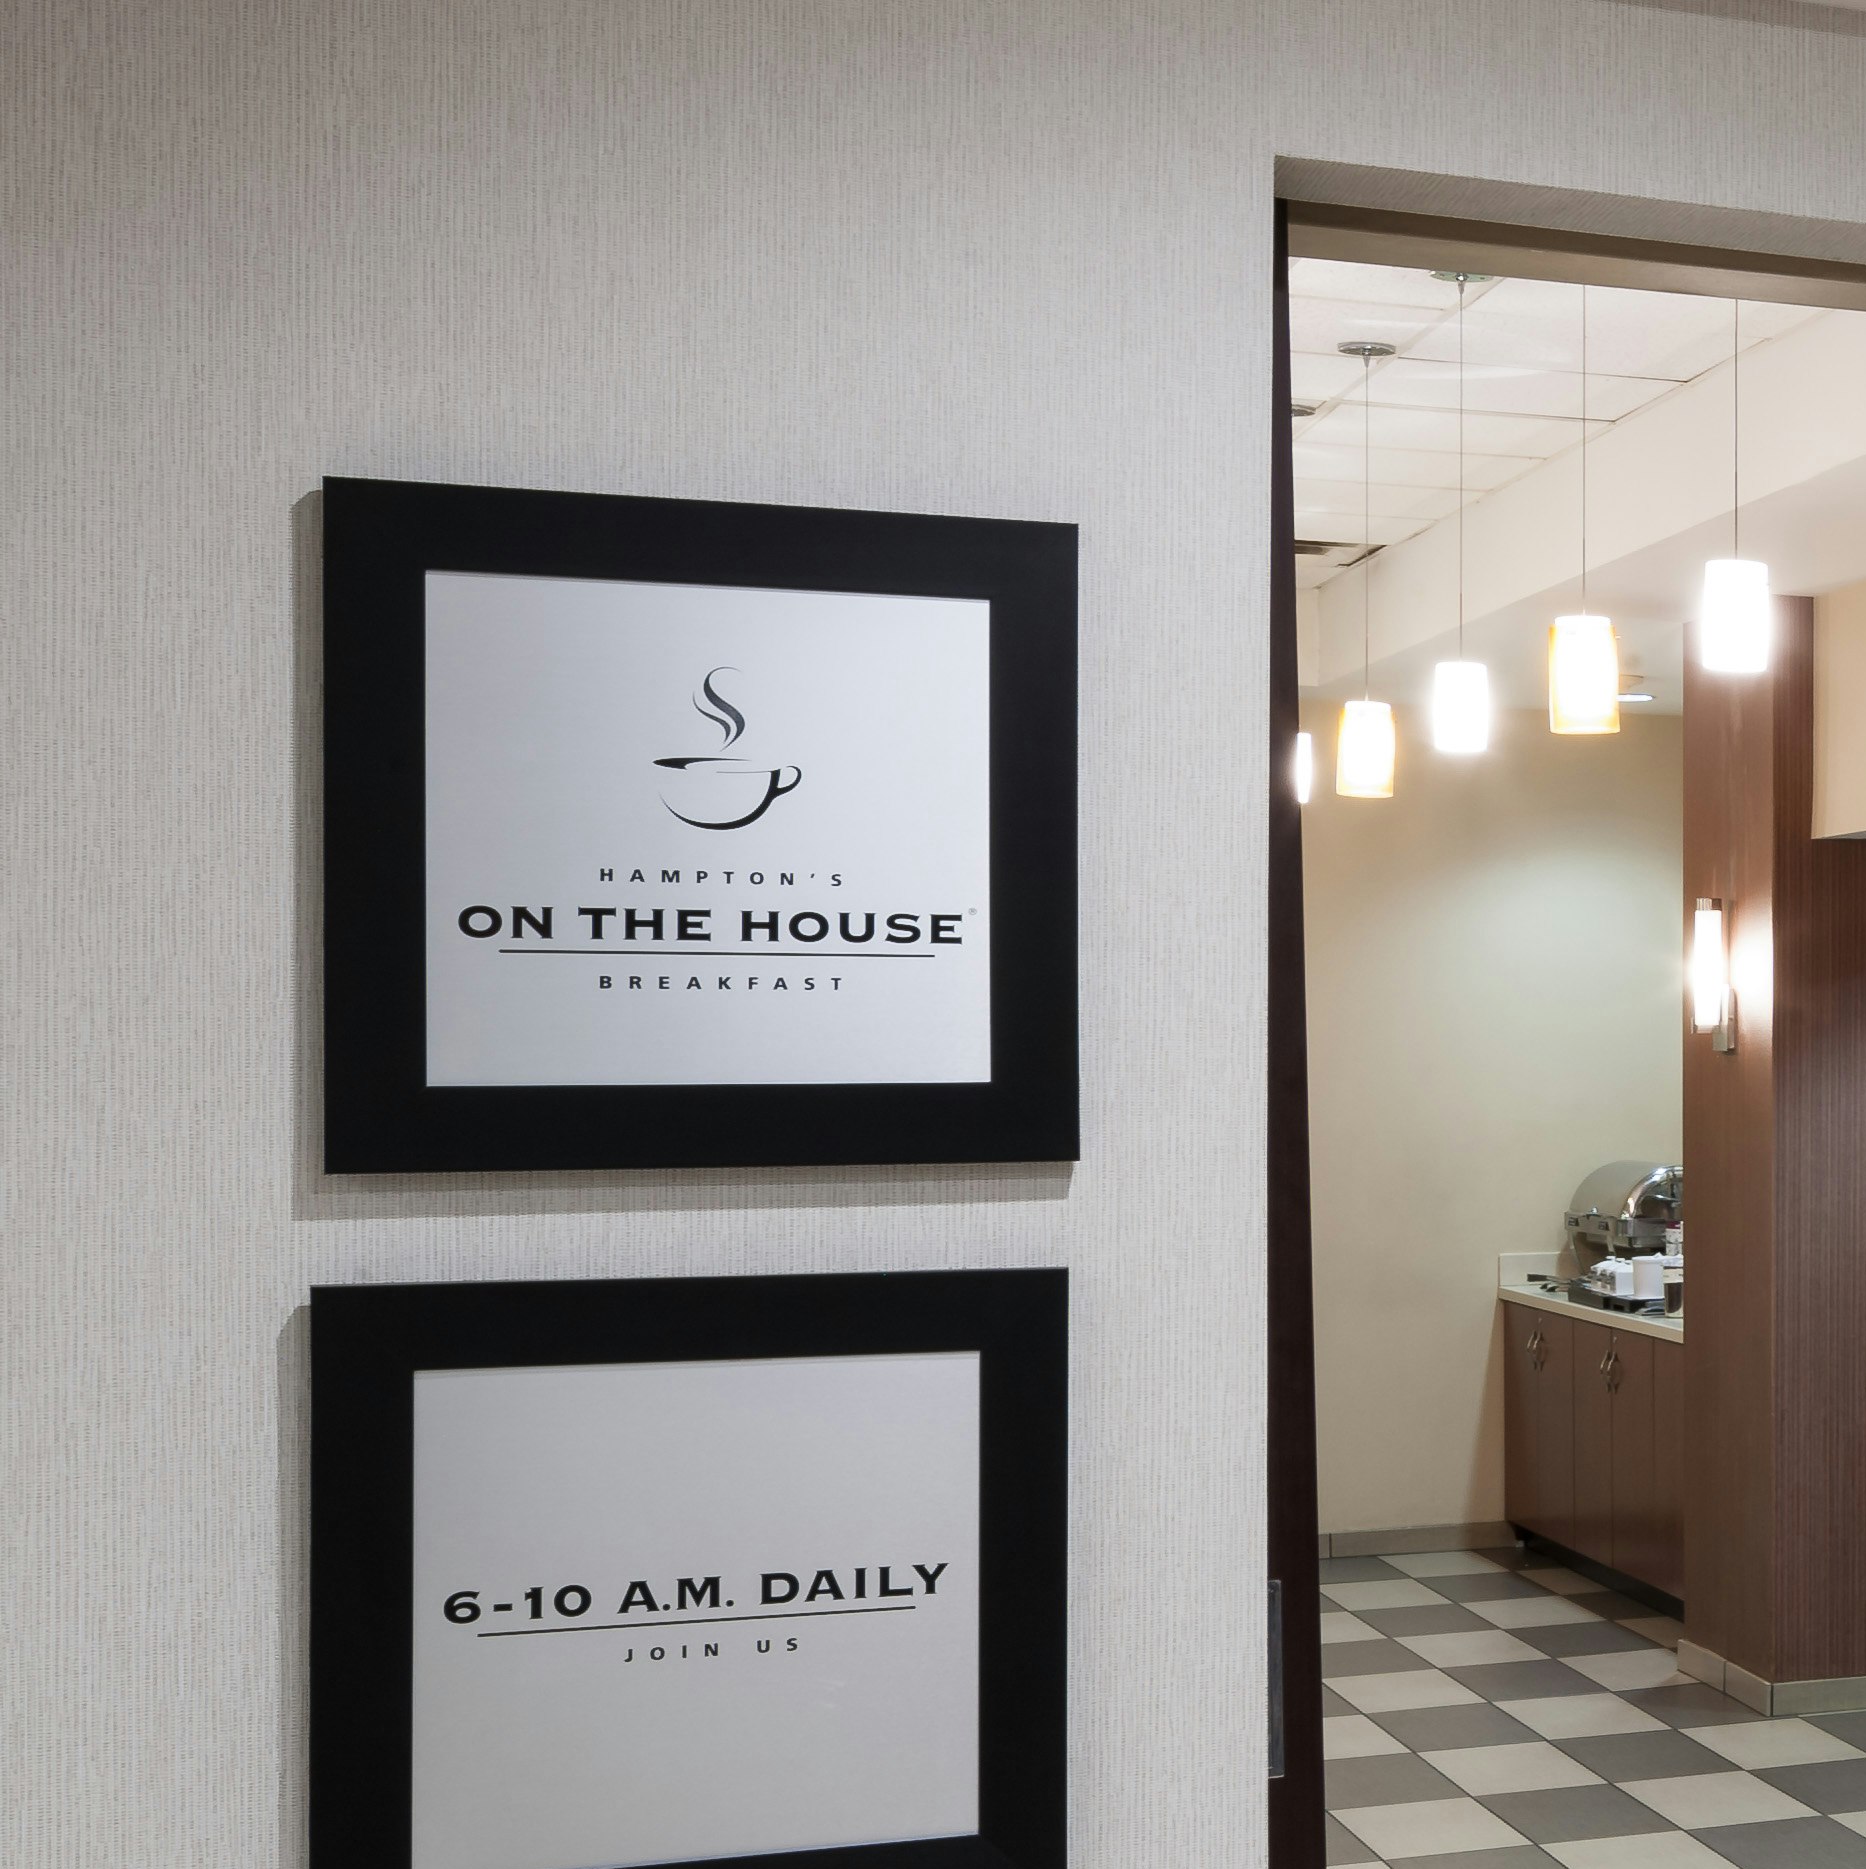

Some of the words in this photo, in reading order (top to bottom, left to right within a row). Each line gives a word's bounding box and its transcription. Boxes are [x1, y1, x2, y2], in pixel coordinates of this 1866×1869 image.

[600, 868, 841, 886] HAMPTON'S
[458, 906, 553, 939] ON
[578, 907, 711, 941] THE
[600, 976, 841, 990] BREAKFAST
[443, 1584, 593, 1625] 6-10
[617, 1576, 734, 1614] A.M.
[760, 1563, 949, 1605] DAILY
[624, 1643, 718, 1662] JOIN
[757, 1638, 797, 1653] US
